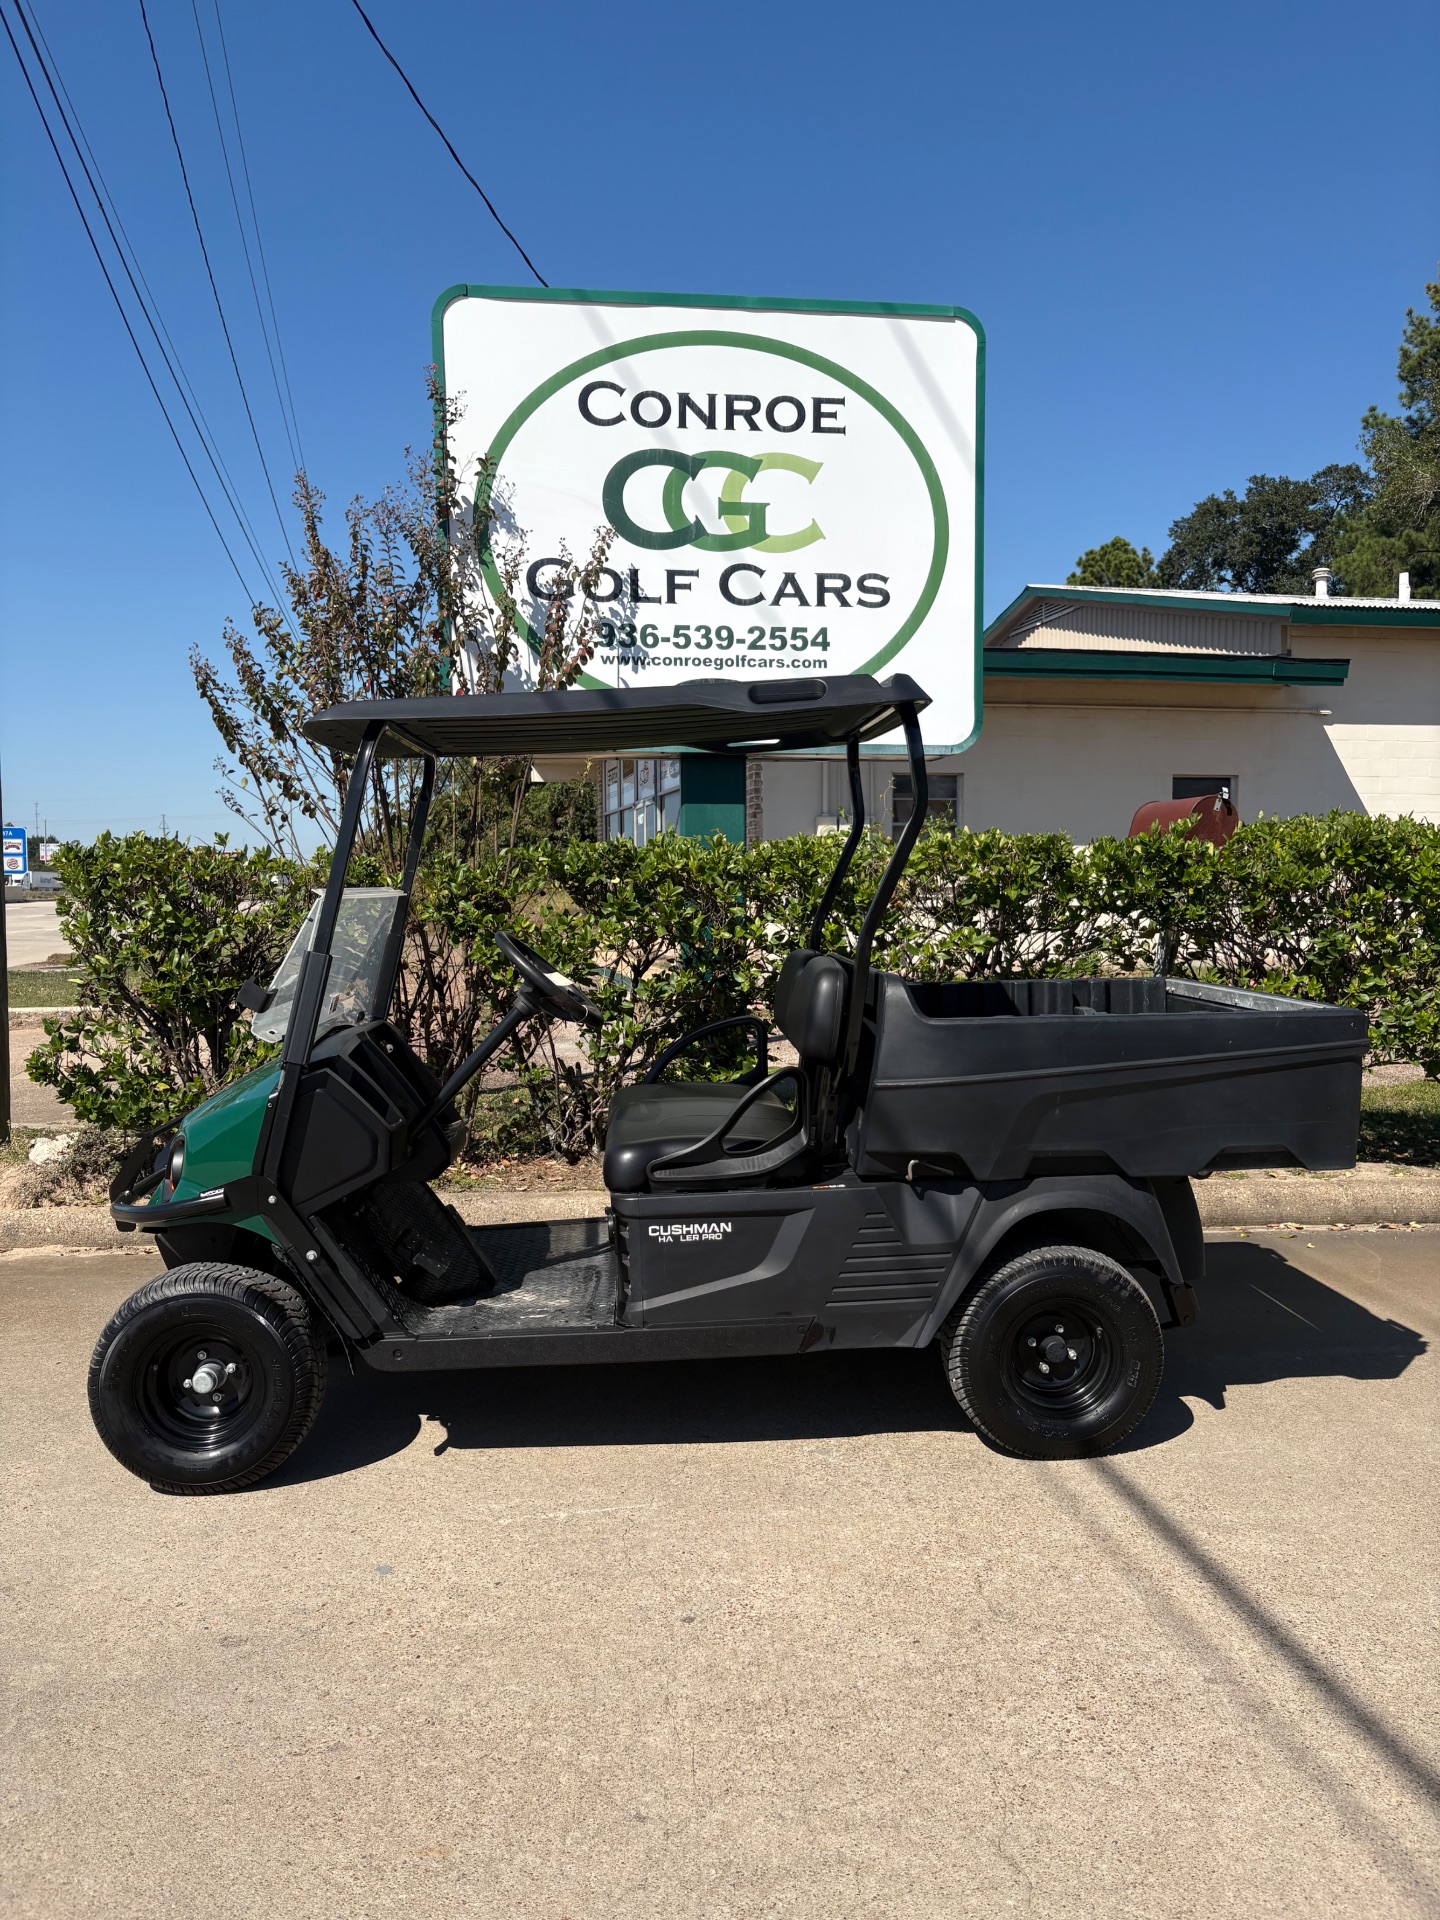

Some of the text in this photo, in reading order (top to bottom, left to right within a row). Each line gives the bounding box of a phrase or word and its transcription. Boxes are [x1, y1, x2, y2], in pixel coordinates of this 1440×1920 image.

[577, 380, 847, 436] CONROE
[526, 557, 892, 609] GOLF CARS
[599, 622, 831, 652] 936-539-2554
[600, 654, 828, 670] www.conroegolfcars.com
[648, 1222, 732, 1236] CUSHMAN
